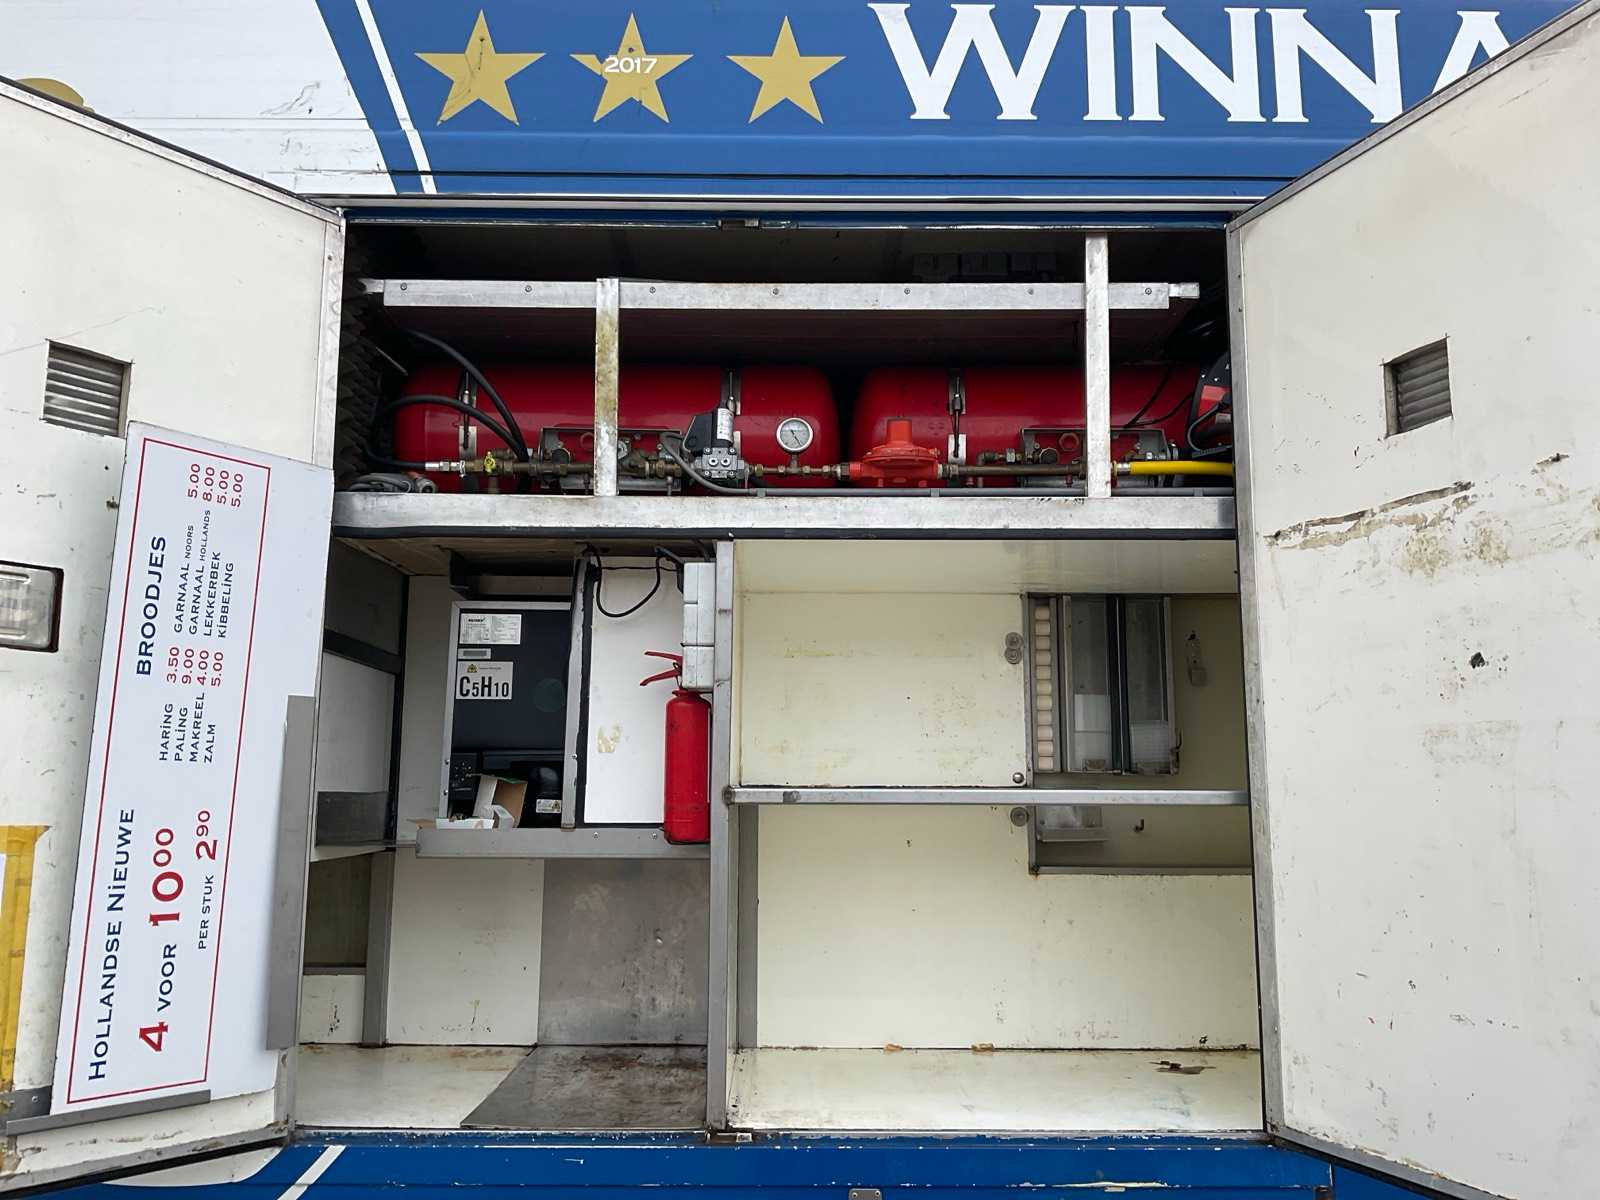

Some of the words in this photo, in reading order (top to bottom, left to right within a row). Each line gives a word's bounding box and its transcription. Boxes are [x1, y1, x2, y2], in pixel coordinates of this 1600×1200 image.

[604, 56, 657, 73] 2017
[188, 463, 201, 498] 5.00
[202, 467, 215, 502] 8.00
[231, 473, 244, 508] 5.00
[185, 525, 194, 559] NOORS
[199, 510, 211, 561] HOLLANDS
[203, 551, 221, 637] LEKKERBEK
[217, 470, 230, 504] 5.00
[136, 536, 166, 676] BROODJES
[174, 563, 190, 633] GARNAAL
[189, 565, 205, 635] GARNAAL
[166, 647, 180, 683] 3.50
[181, 649, 195, 684] 9.00
[196, 650, 209, 686] 4.00
[459, 675, 510, 698] C5H10
[204, 724, 216, 764] ZALM
[211, 652, 224, 687] 5.00
[189, 692, 204, 762] MAKREEL
[202, 875, 214, 914] STUK
[198, 919, 209, 949] PER
[88, 921, 122, 1080] HOLLANDSE
[139, 1021, 168, 1052] 4
[157, 944, 177, 1012] VOOR
